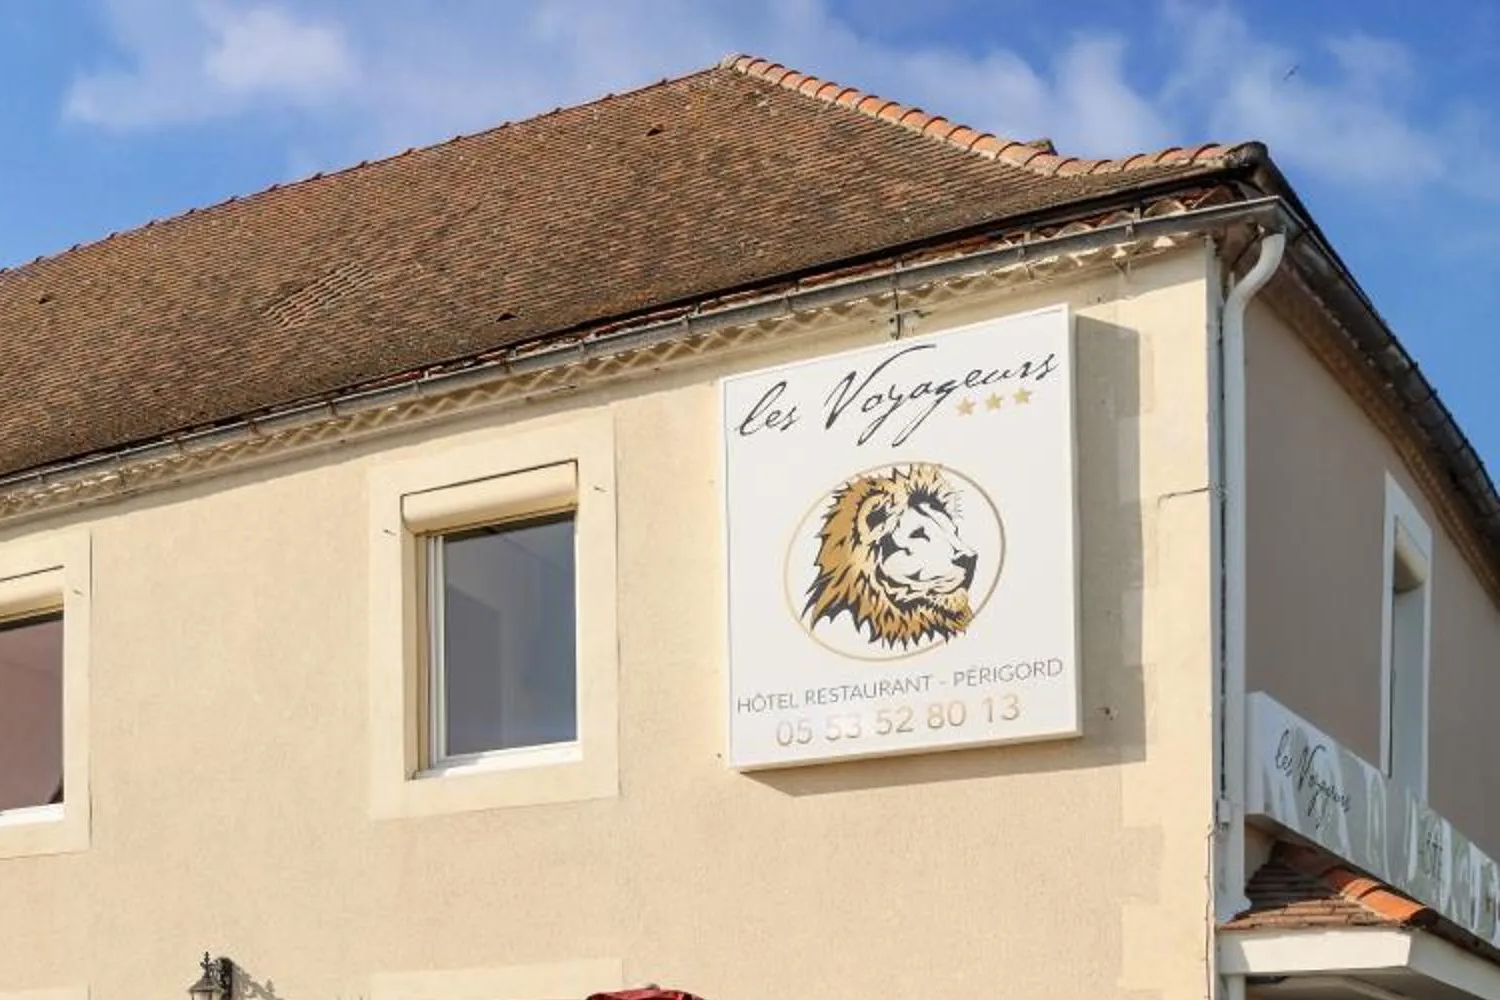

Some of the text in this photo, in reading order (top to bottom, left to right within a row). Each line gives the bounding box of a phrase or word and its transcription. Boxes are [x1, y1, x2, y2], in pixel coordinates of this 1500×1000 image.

[823, 343, 1059, 448] Voyageurs
[804, 674, 933, 705] RESTAURANT
[775, 692, 1021, 747] 05 53 52 80 13
